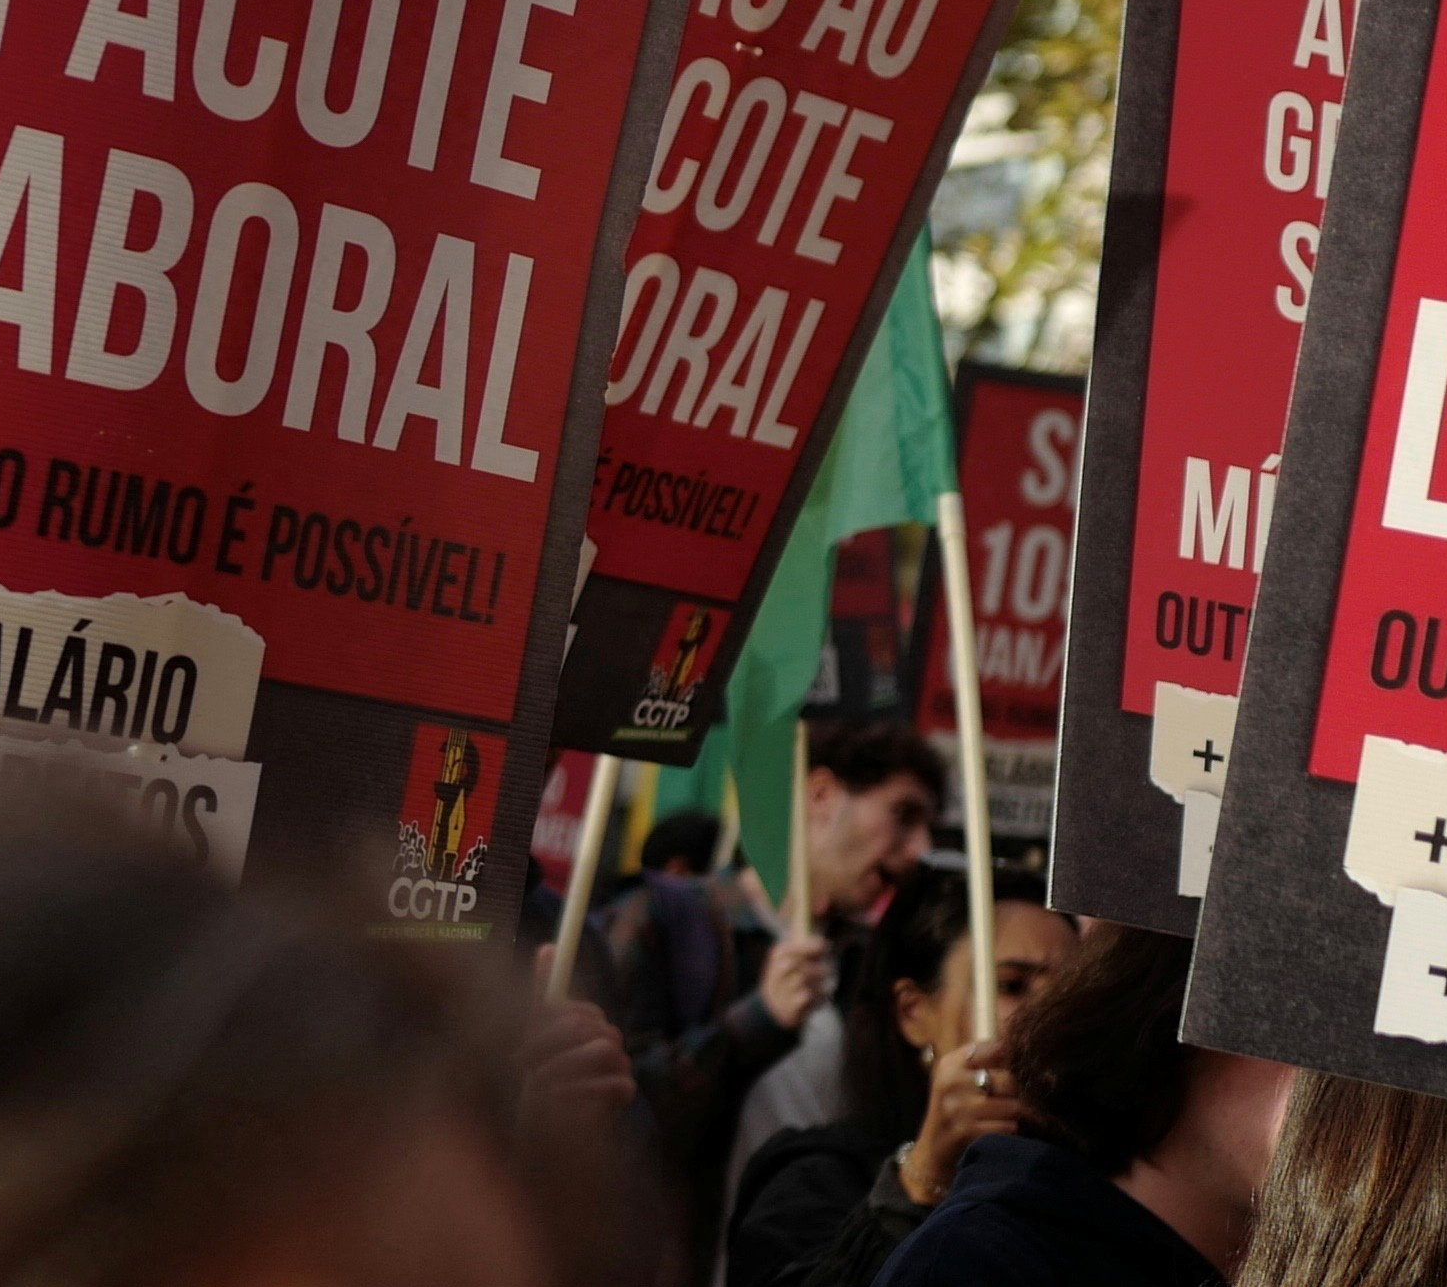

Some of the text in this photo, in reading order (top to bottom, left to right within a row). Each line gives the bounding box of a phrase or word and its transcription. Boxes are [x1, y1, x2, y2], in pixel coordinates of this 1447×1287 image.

[643, 57, 891, 265] COTE
[606, 252, 826, 451] ORAL
[36, 459, 206, 567] RUMO
[216, 482, 258, 576] É
[262, 503, 506, 625] POSSÍVEL!
[604, 459, 761, 542] POSSÍVEL!
[1157, 590, 1251, 663] OUT
[389, 876, 478, 923] CGTP
